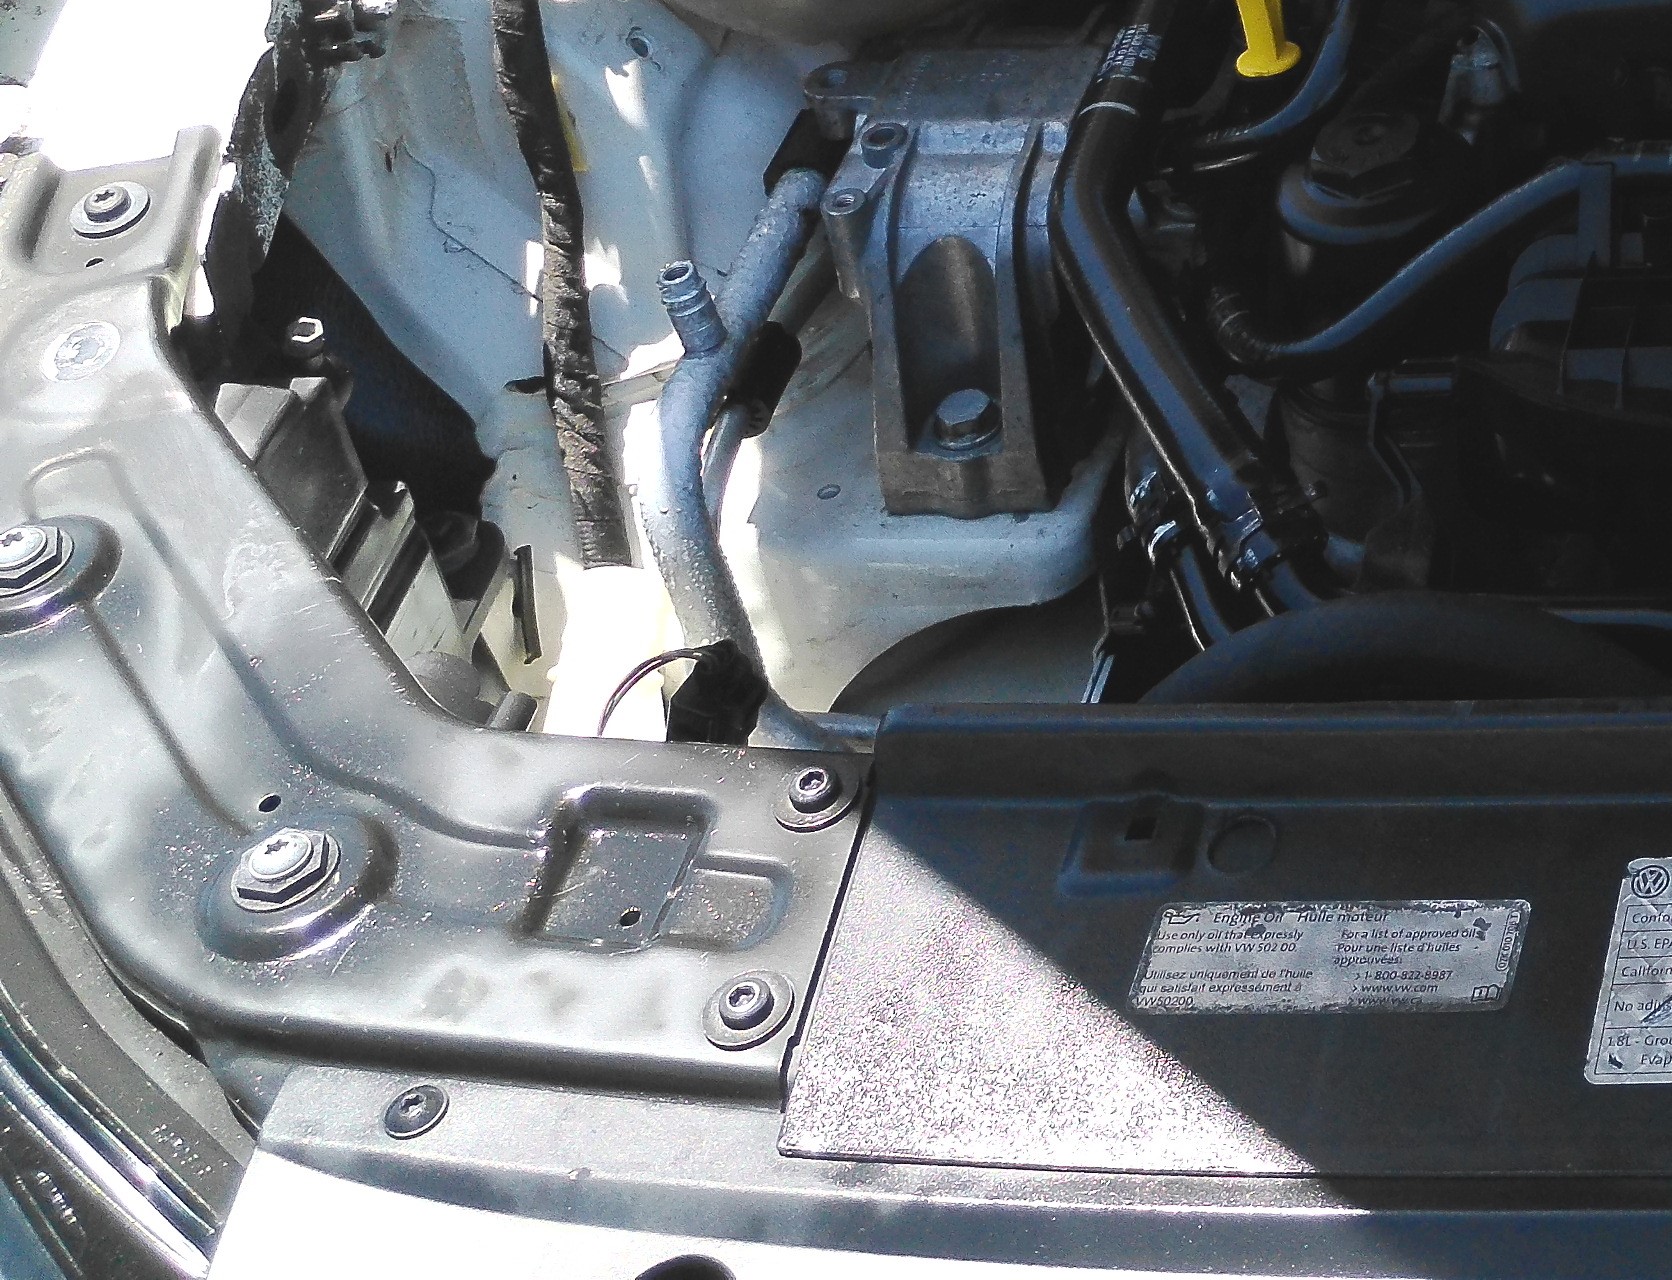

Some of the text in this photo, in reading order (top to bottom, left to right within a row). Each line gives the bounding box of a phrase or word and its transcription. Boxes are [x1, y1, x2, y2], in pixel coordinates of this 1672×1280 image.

[1213, 911, 1389, 927] Engine Oil Huile moteur
[1157, 929, 1179, 940] Use
[1179, 929, 1206, 942] only
[1207, 929, 1223, 940] oil
[1371, 928, 1389, 939] list
[1390, 928, 1404, 939] of
[1405, 928, 1459, 942] approved
[1152, 943, 1202, 955] complies
[1205, 942, 1232, 953] with
[1234, 942, 1256, 954] VW
[1257, 942, 1278, 953] 502
[1335, 941, 1461, 953] Pour une liste d'huiles
[1626, 938, 1651, 950] U.S.
[1143, 967, 1313, 983] Utilisez uniquement de l'huile
[1139, 981, 1292, 996] qui satisfait expressément
[1361, 983, 1439, 994] www.vw.com
[1613, 1000, 1634, 1012] No
